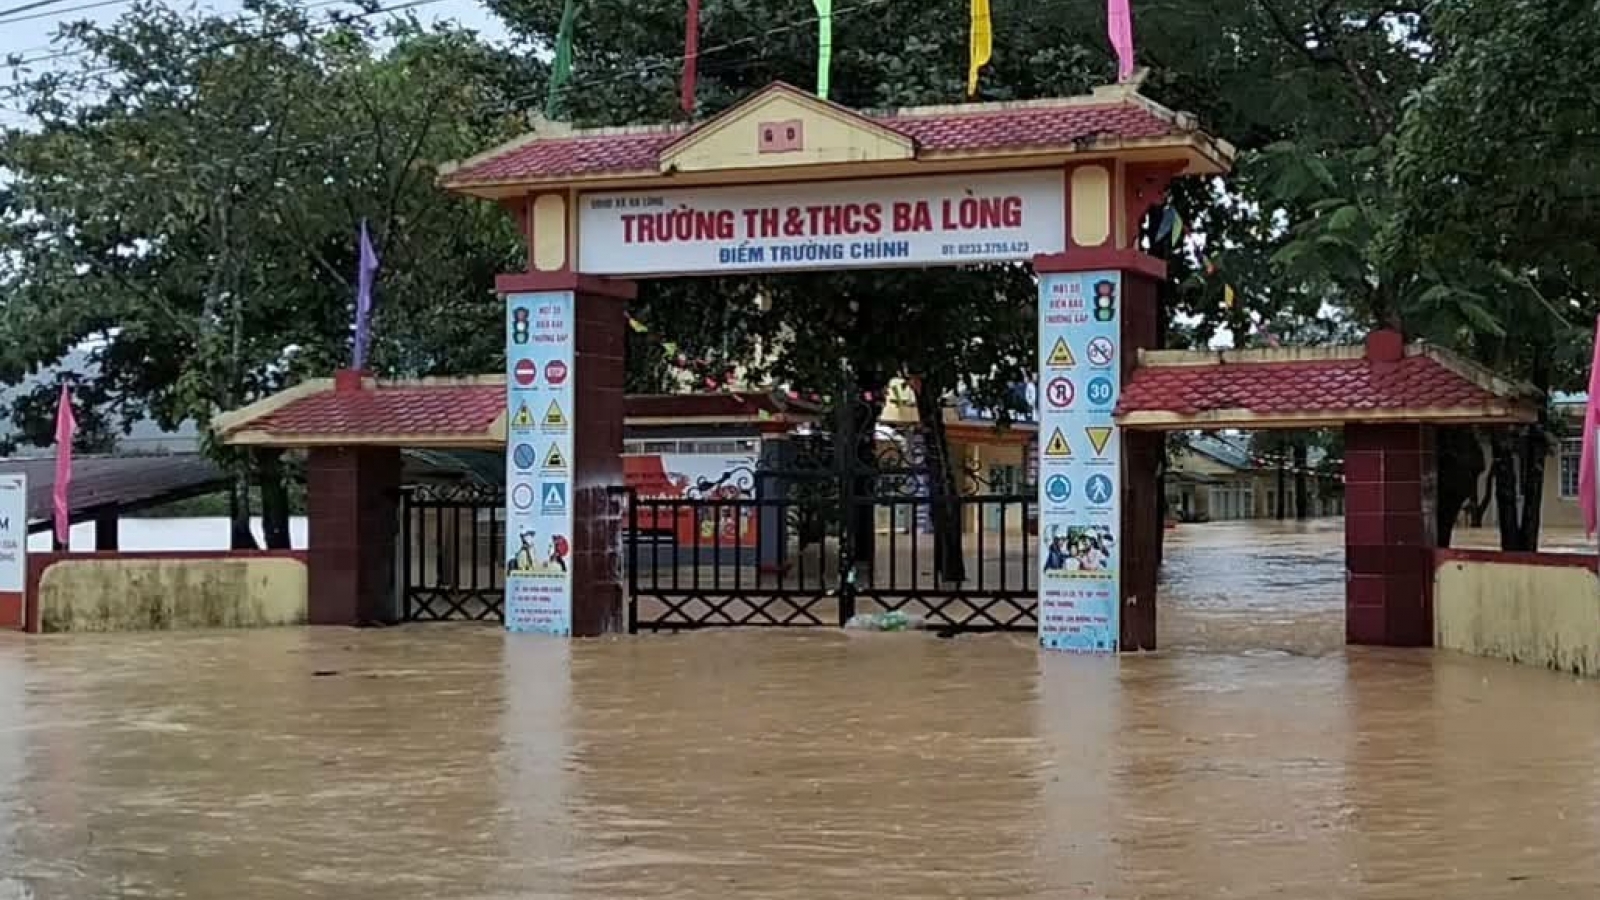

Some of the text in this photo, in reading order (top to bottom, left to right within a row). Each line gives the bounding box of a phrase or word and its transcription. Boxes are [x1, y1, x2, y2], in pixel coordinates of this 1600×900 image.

[620, 203, 735, 244] TRƯỜNG
[892, 200, 933, 233] BA
[942, 186, 1022, 231] LÒNG
[771, 239, 843, 263] TRƯỜNG
[850, 237, 910, 260] CHÍNH
[1090, 384, 1110, 398] 30
